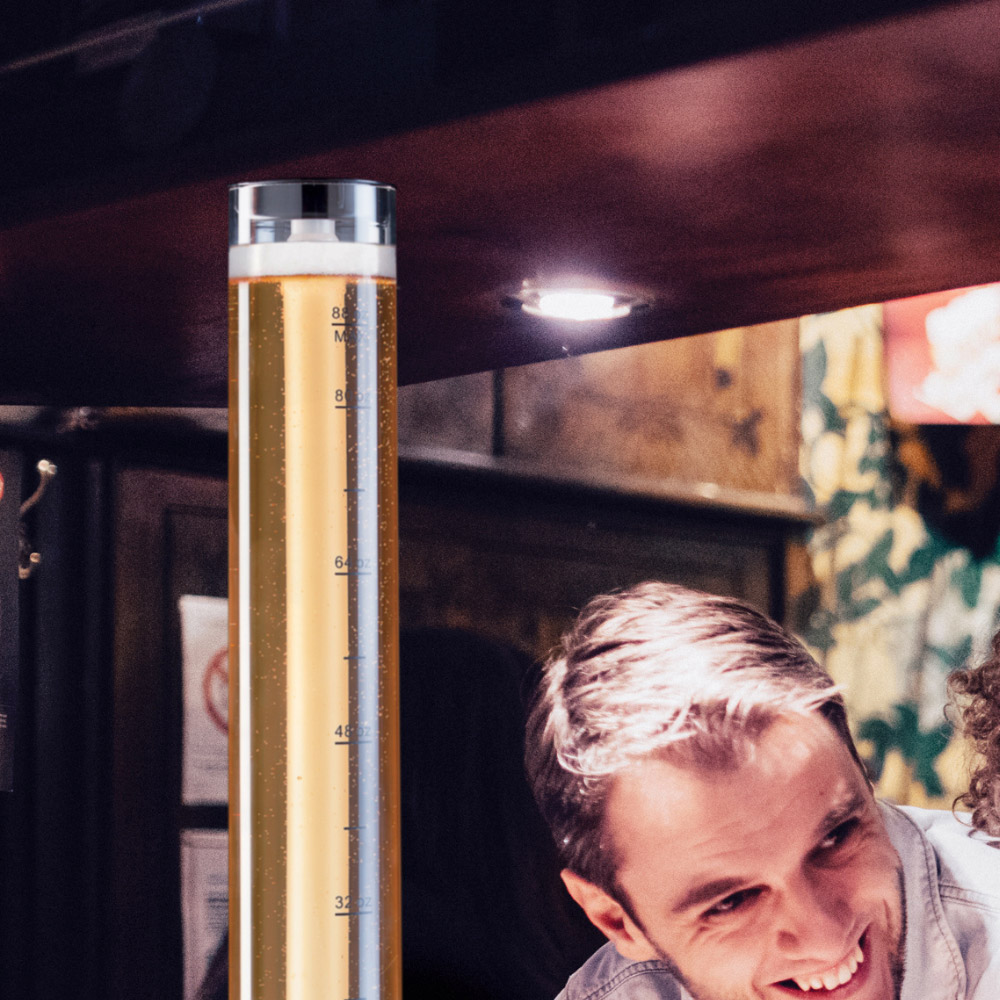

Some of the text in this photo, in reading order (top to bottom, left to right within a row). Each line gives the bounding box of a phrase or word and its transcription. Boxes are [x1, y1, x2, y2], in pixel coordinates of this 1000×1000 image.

[335, 389, 353, 402] 80
[334, 555, 371, 569] 64 oz
[334, 724, 371, 738] 48 oz
[335, 895, 372, 909] 32 oz
